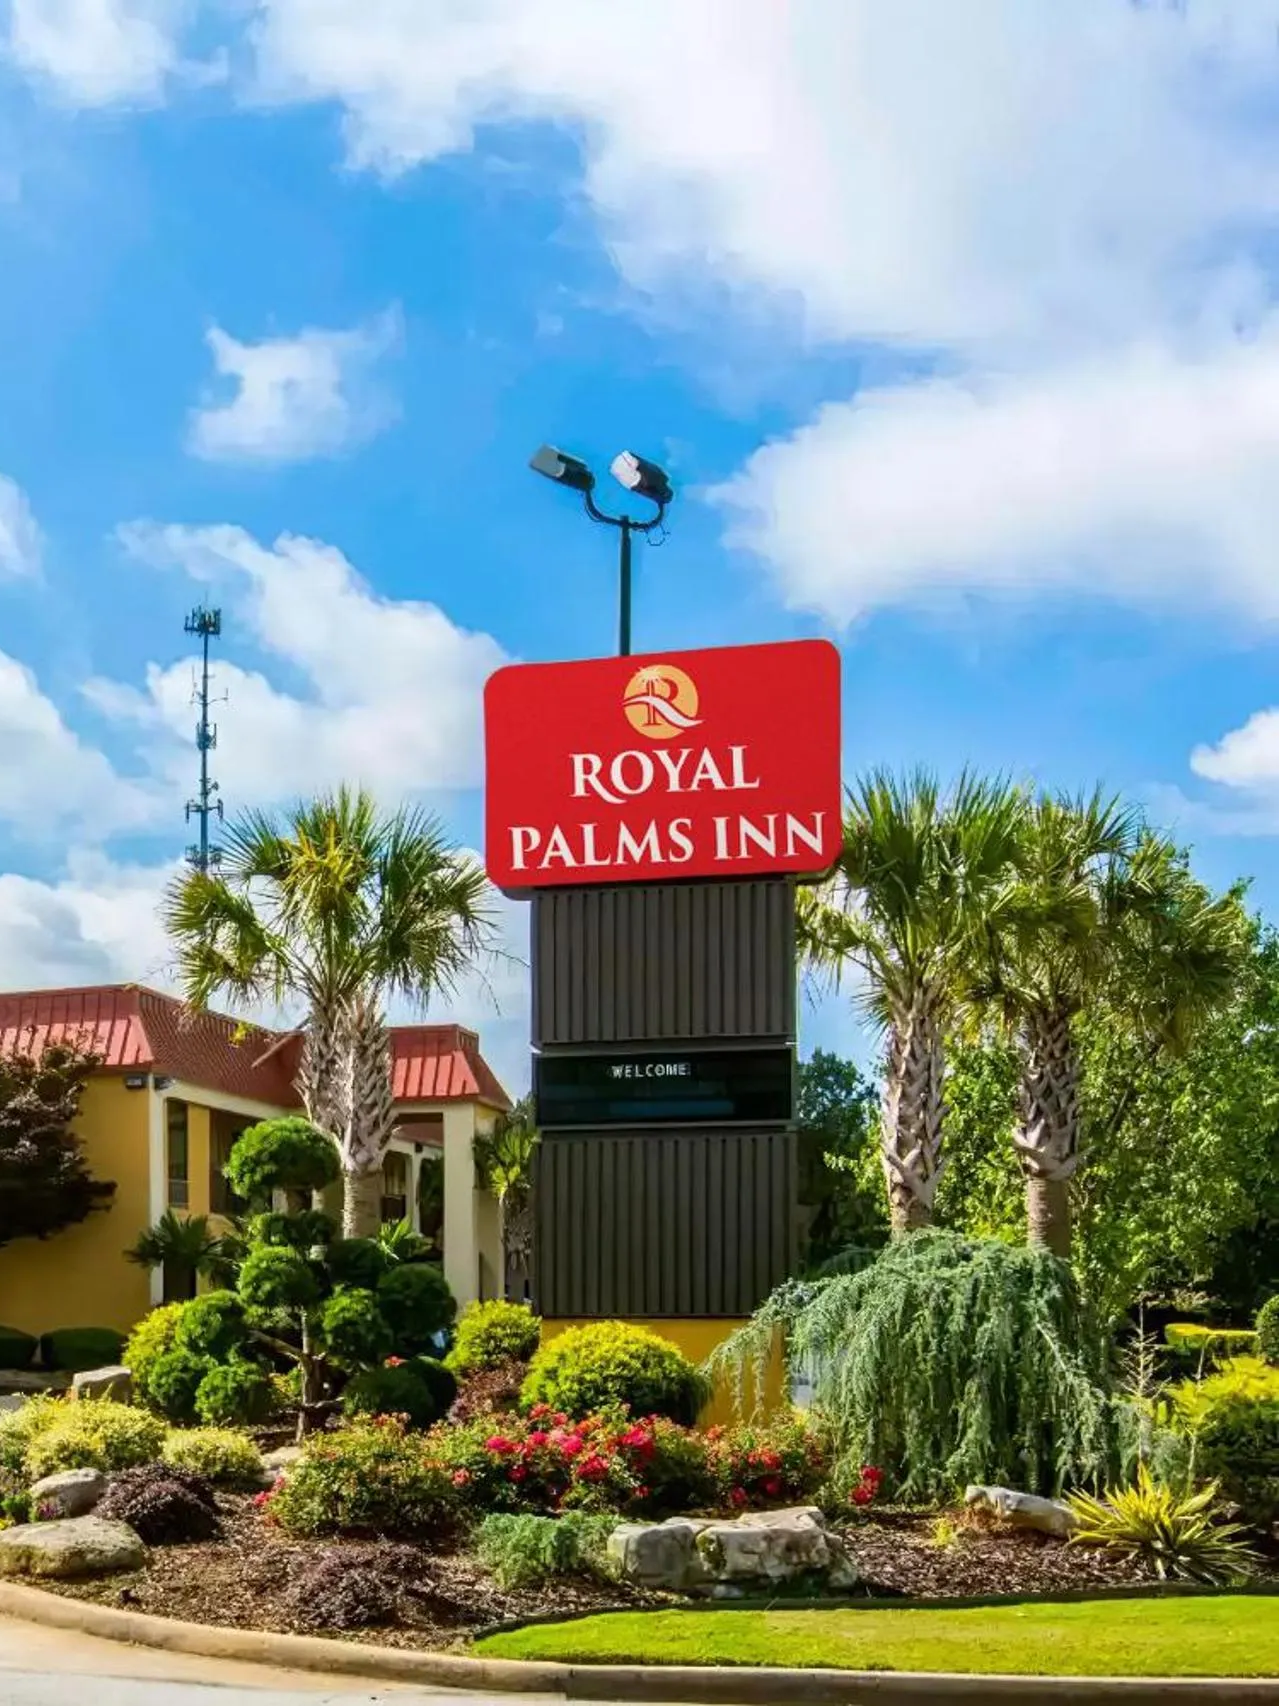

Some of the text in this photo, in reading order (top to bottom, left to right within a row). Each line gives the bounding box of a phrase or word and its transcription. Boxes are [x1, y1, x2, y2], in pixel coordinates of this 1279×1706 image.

[570, 745, 760, 803] ROYAL
[508, 812, 826, 870] PALMS INN
[611, 1063, 688, 1079] WELCOME
